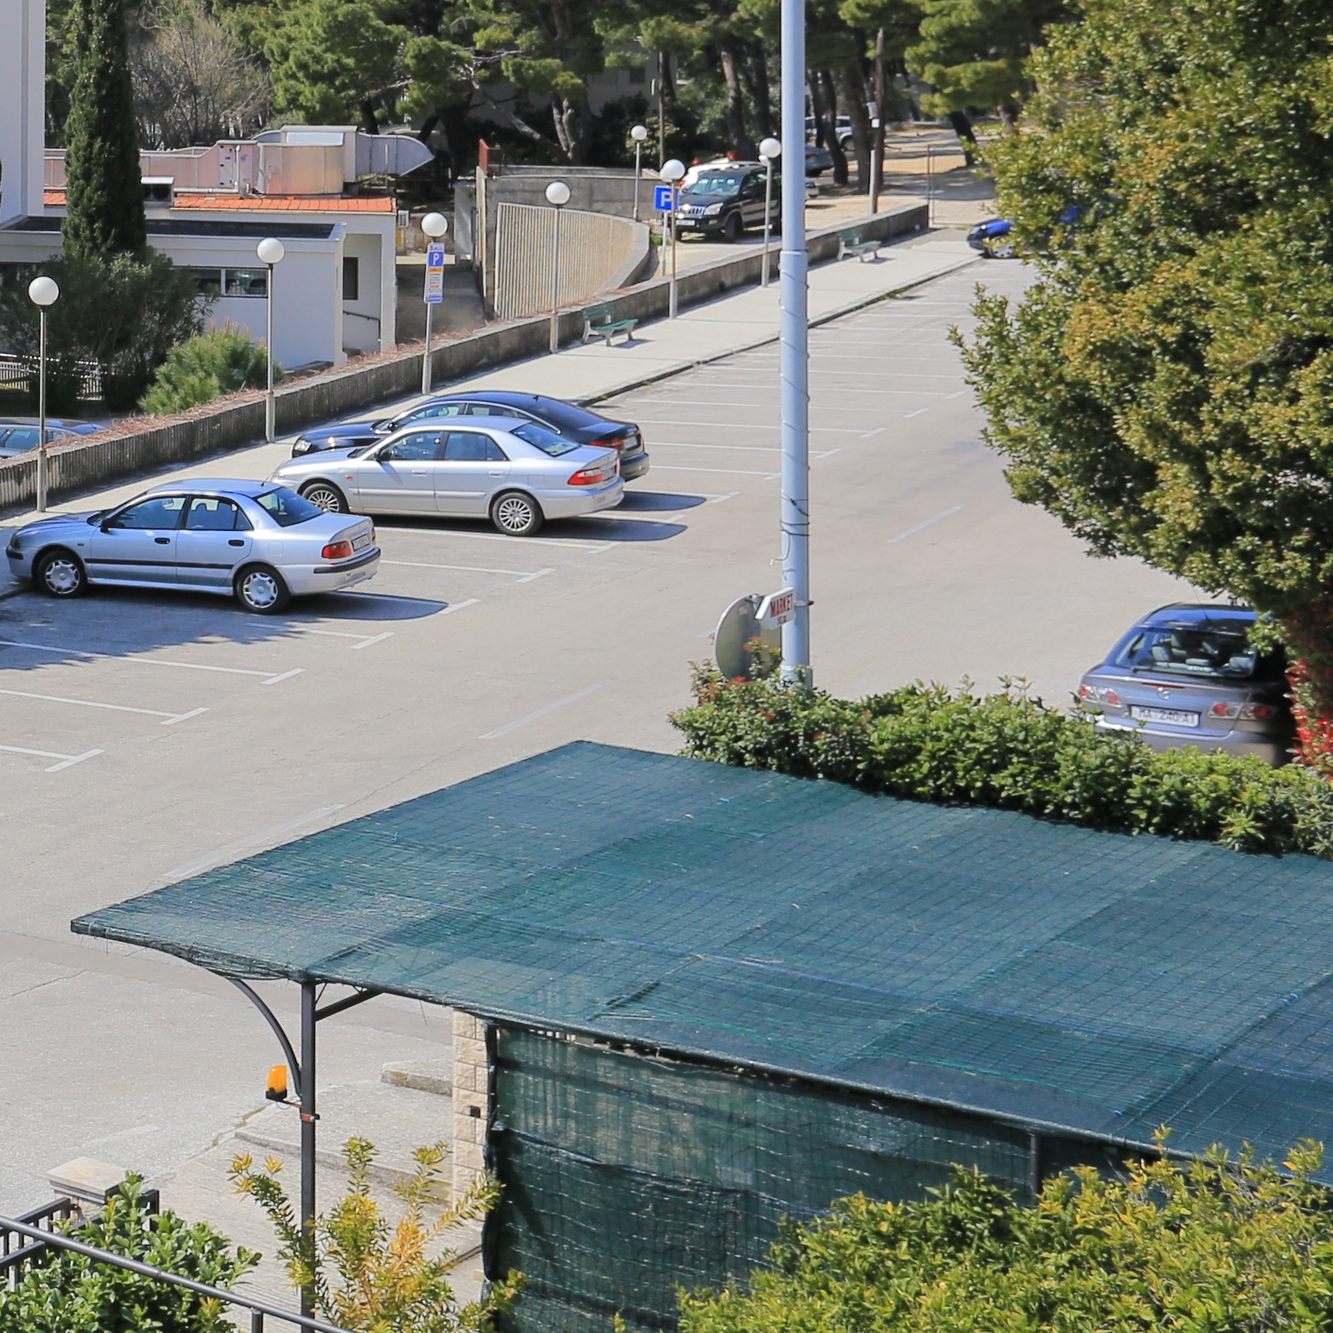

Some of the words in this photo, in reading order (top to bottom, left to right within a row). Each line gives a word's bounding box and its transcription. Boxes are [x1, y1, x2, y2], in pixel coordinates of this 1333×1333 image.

[661, 191, 674, 207] P
[433, 253, 439, 266] P
[770, 593, 793, 618] MARKET
[1139, 708, 1151, 718] MA
